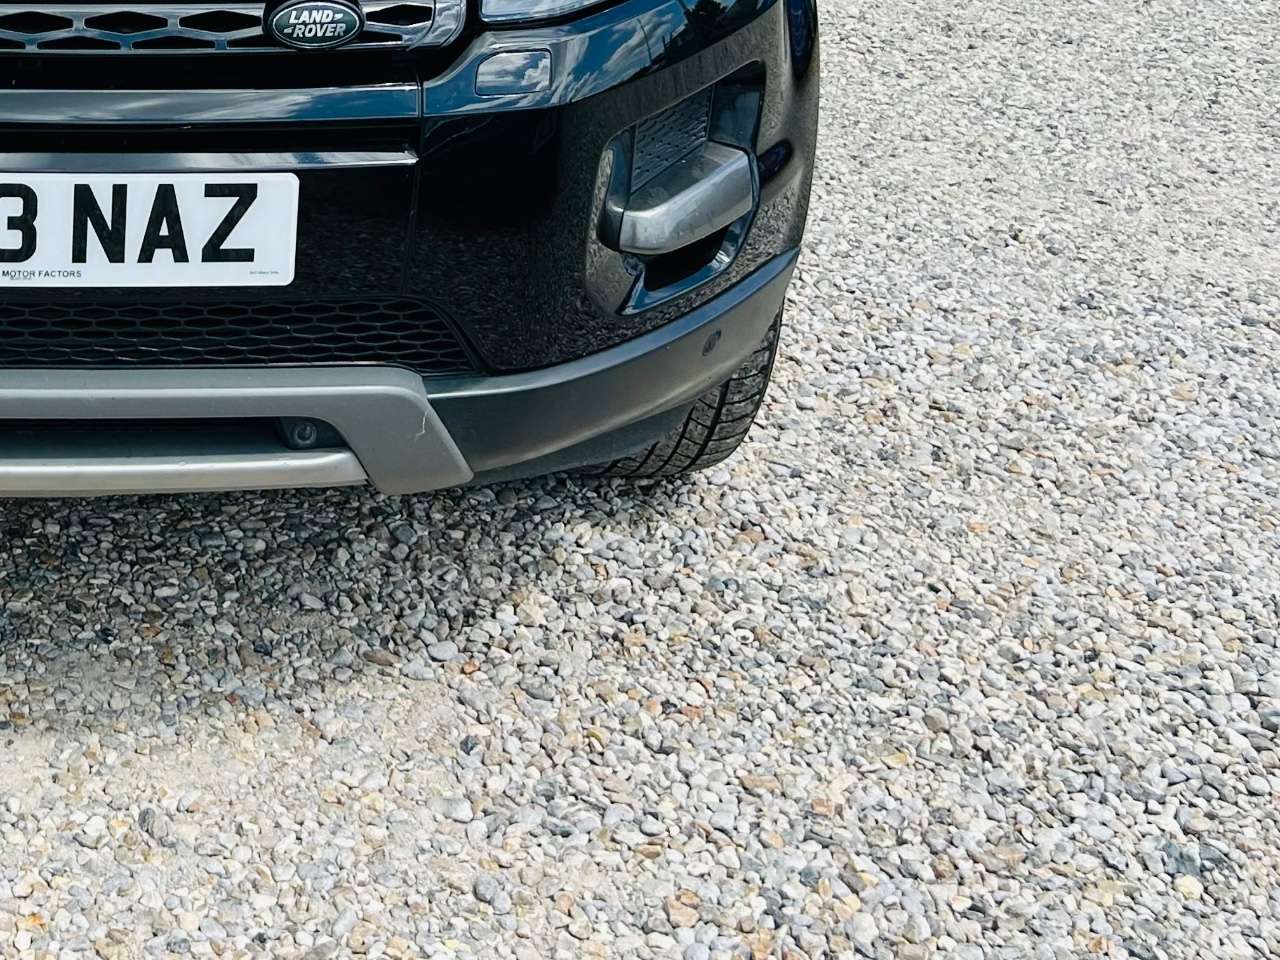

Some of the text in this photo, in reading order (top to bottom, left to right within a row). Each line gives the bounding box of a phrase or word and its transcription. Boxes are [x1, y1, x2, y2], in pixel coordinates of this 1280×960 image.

[289, 10, 334, 24] LAND
[292, 23, 346, 38] ROVER
[71, 183, 258, 263] NAZ
[1, 269, 35, 278] MOTOR
[38, 270, 82, 278] FACTORS
